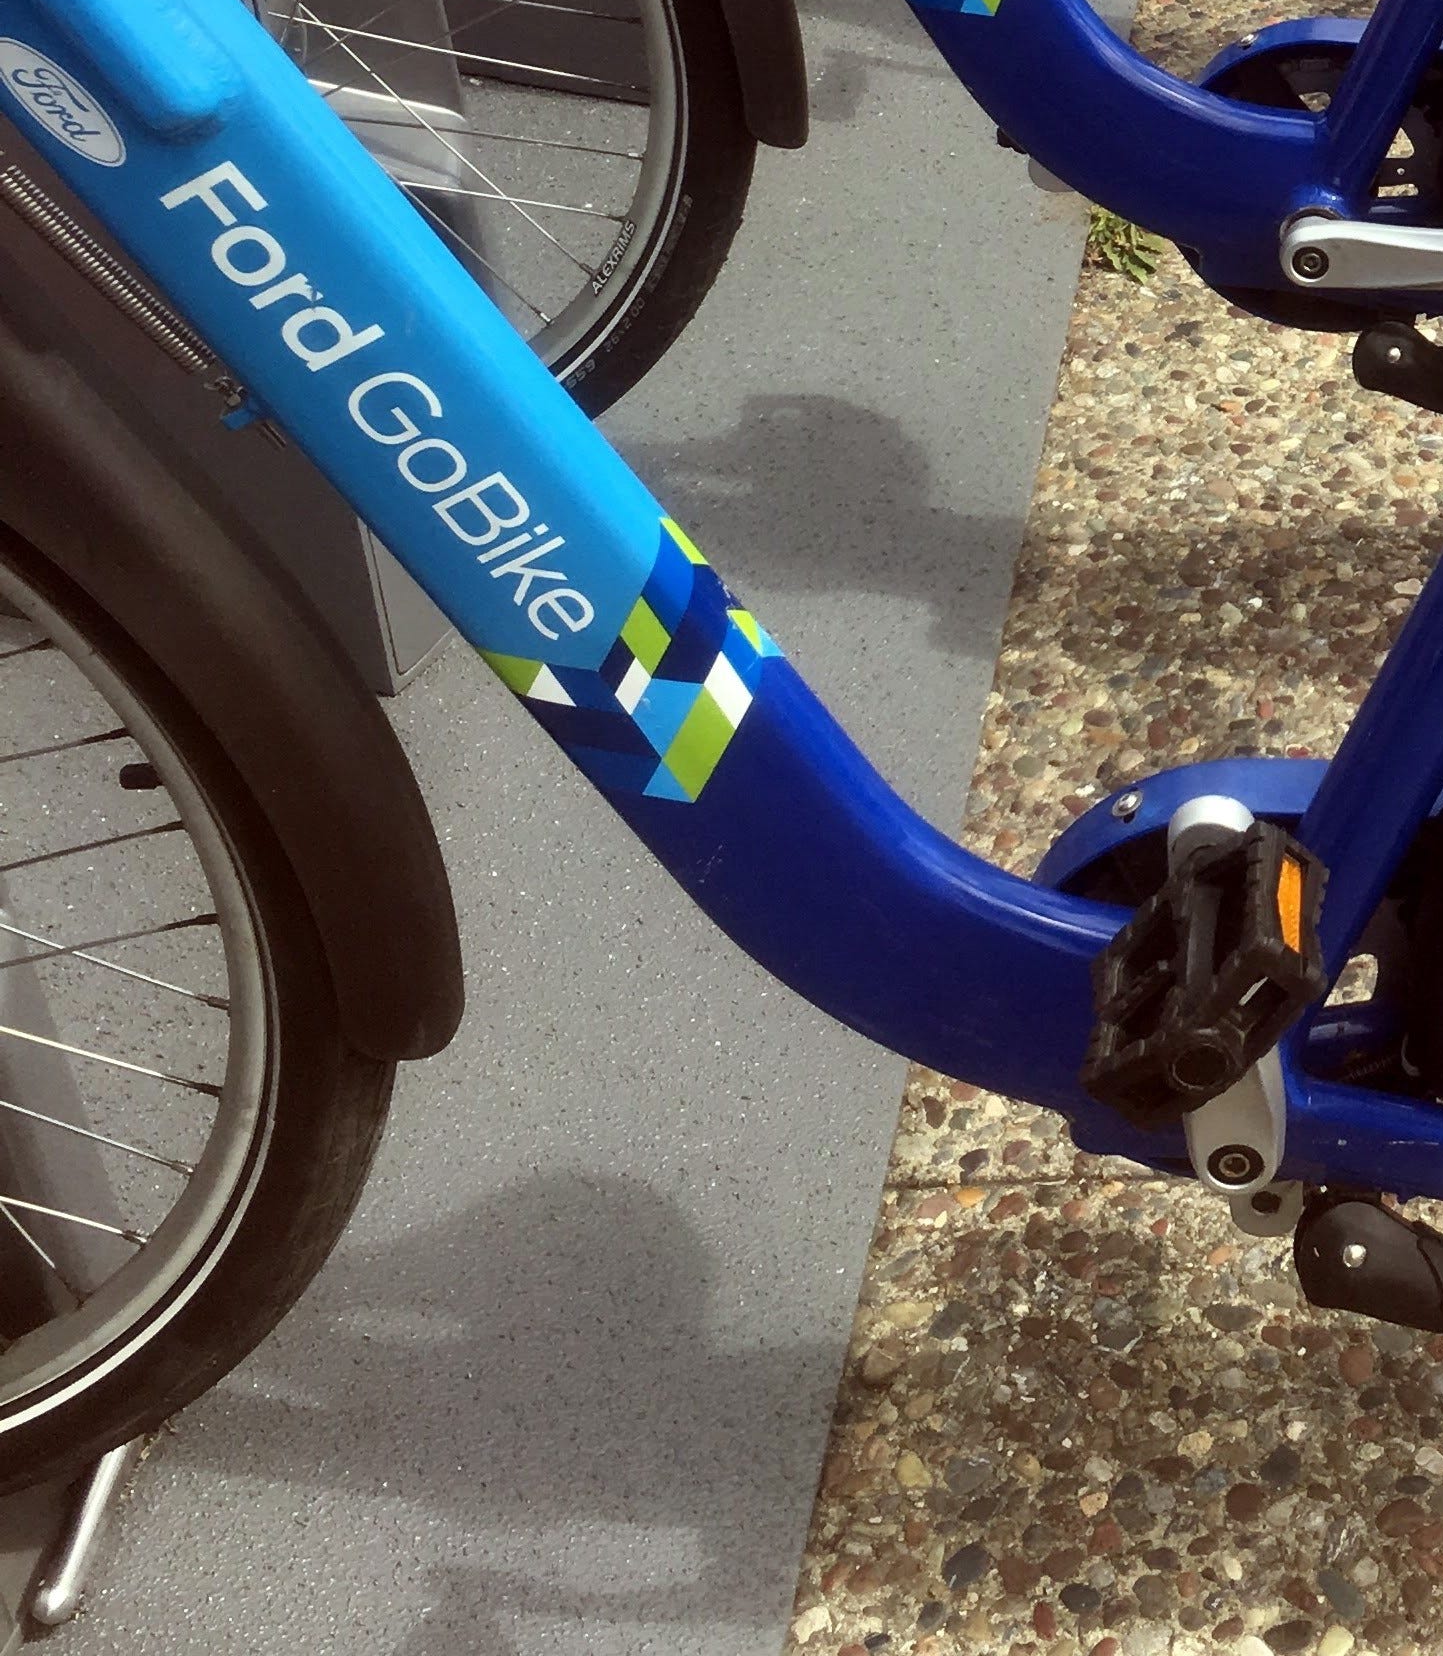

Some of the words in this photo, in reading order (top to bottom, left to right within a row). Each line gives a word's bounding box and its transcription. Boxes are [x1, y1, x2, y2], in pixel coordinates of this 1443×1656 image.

[12, 47, 92, 144] Ford
[592, 219, 636, 296] ALEXRIMS
[159, 159, 385, 373] Ford
[347, 371, 596, 641] GoBike
